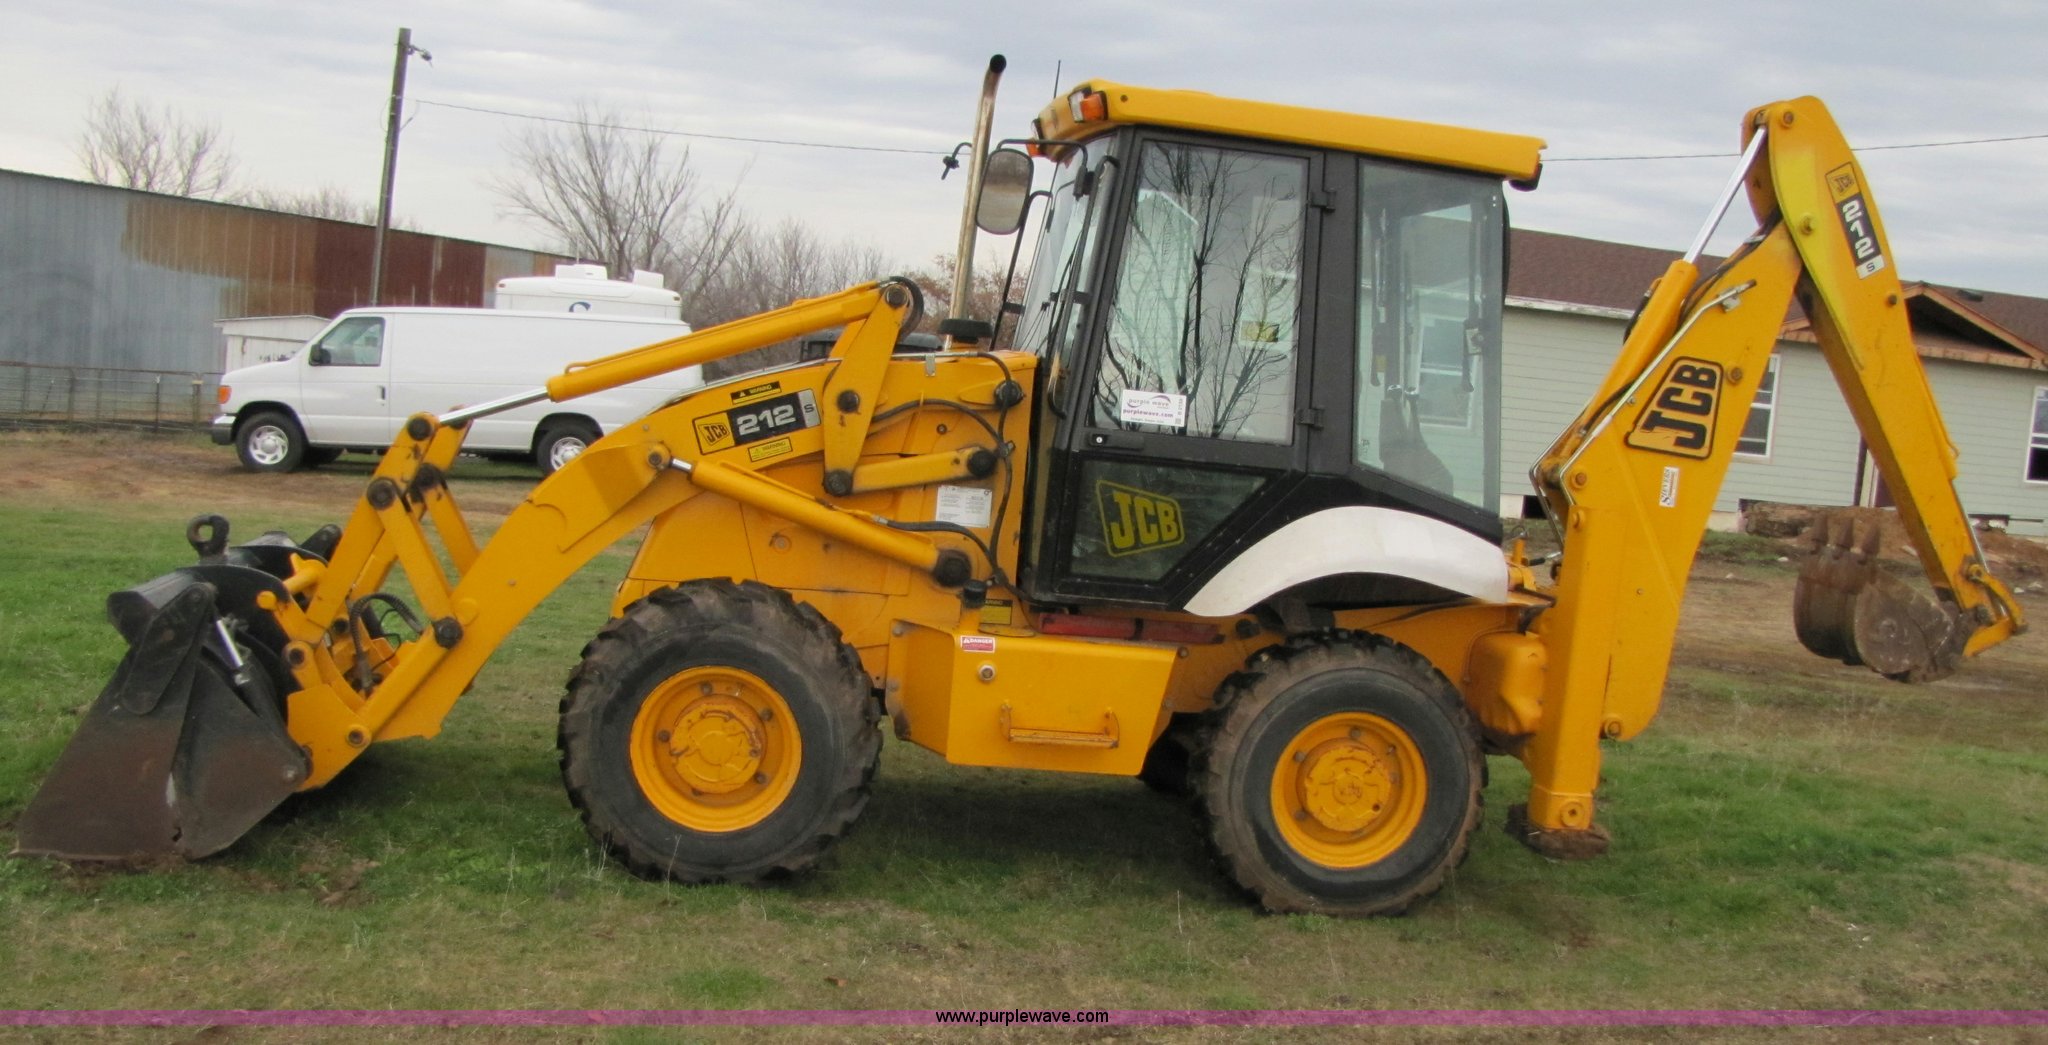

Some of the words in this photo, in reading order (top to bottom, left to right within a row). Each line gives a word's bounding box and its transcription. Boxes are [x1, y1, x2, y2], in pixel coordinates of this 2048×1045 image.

[1842, 200, 1875, 259] 212
[1866, 262, 1876, 272] S
[703, 423, 729, 443] JCB
[737, 405, 795, 435] 212
[804, 403, 815, 413] S
[1123, 408, 1174, 418] purplewave.com
[1128, 397, 1150, 406] purple
[1640, 364, 1717, 450] JCB
[1110, 490, 1179, 549] JCB
